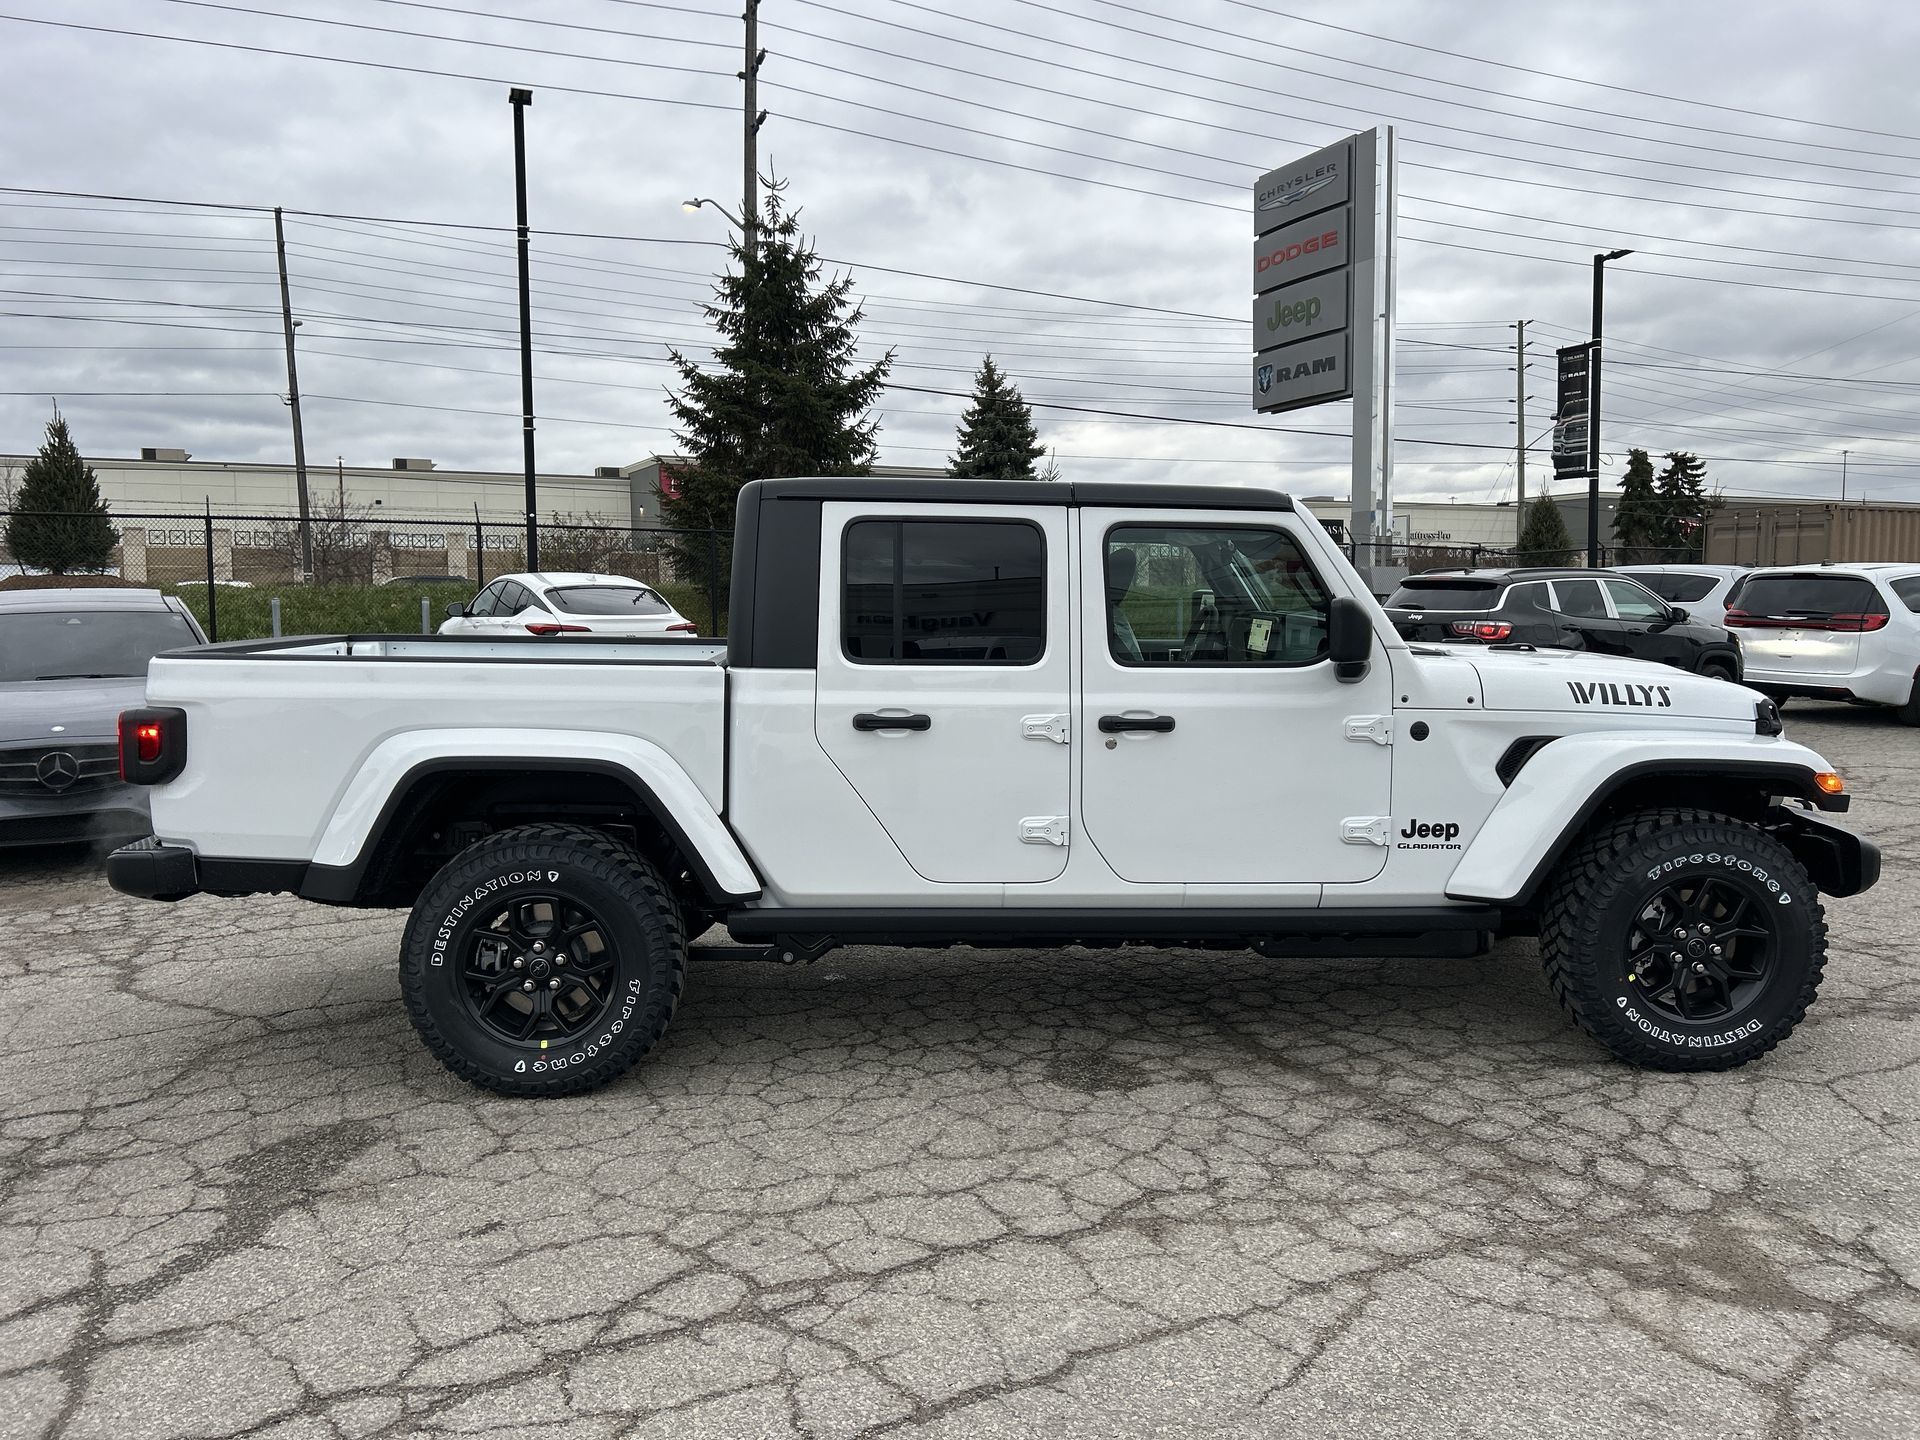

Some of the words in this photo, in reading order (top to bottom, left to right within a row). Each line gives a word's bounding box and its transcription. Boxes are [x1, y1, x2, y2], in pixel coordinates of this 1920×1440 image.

[1259, 163, 1337, 201] CHRYSLER
[1258, 230, 1338, 272] DODGE
[1267, 297, 1320, 331] Jeep
[1277, 356, 1336, 384] RAM
[1323, 526, 1343, 534] ASA
[1408, 613, 1423, 621] Jeep
[1566, 681, 1672, 708] WILLYS
[1401, 818, 1460, 842] Jeep
[1397, 843, 1462, 851] GLADIATOR
[1647, 852, 1780, 893] Firestone
[430, 870, 542, 967] DESTINATION
[1625, 1007, 1764, 1048] DESTINATION
